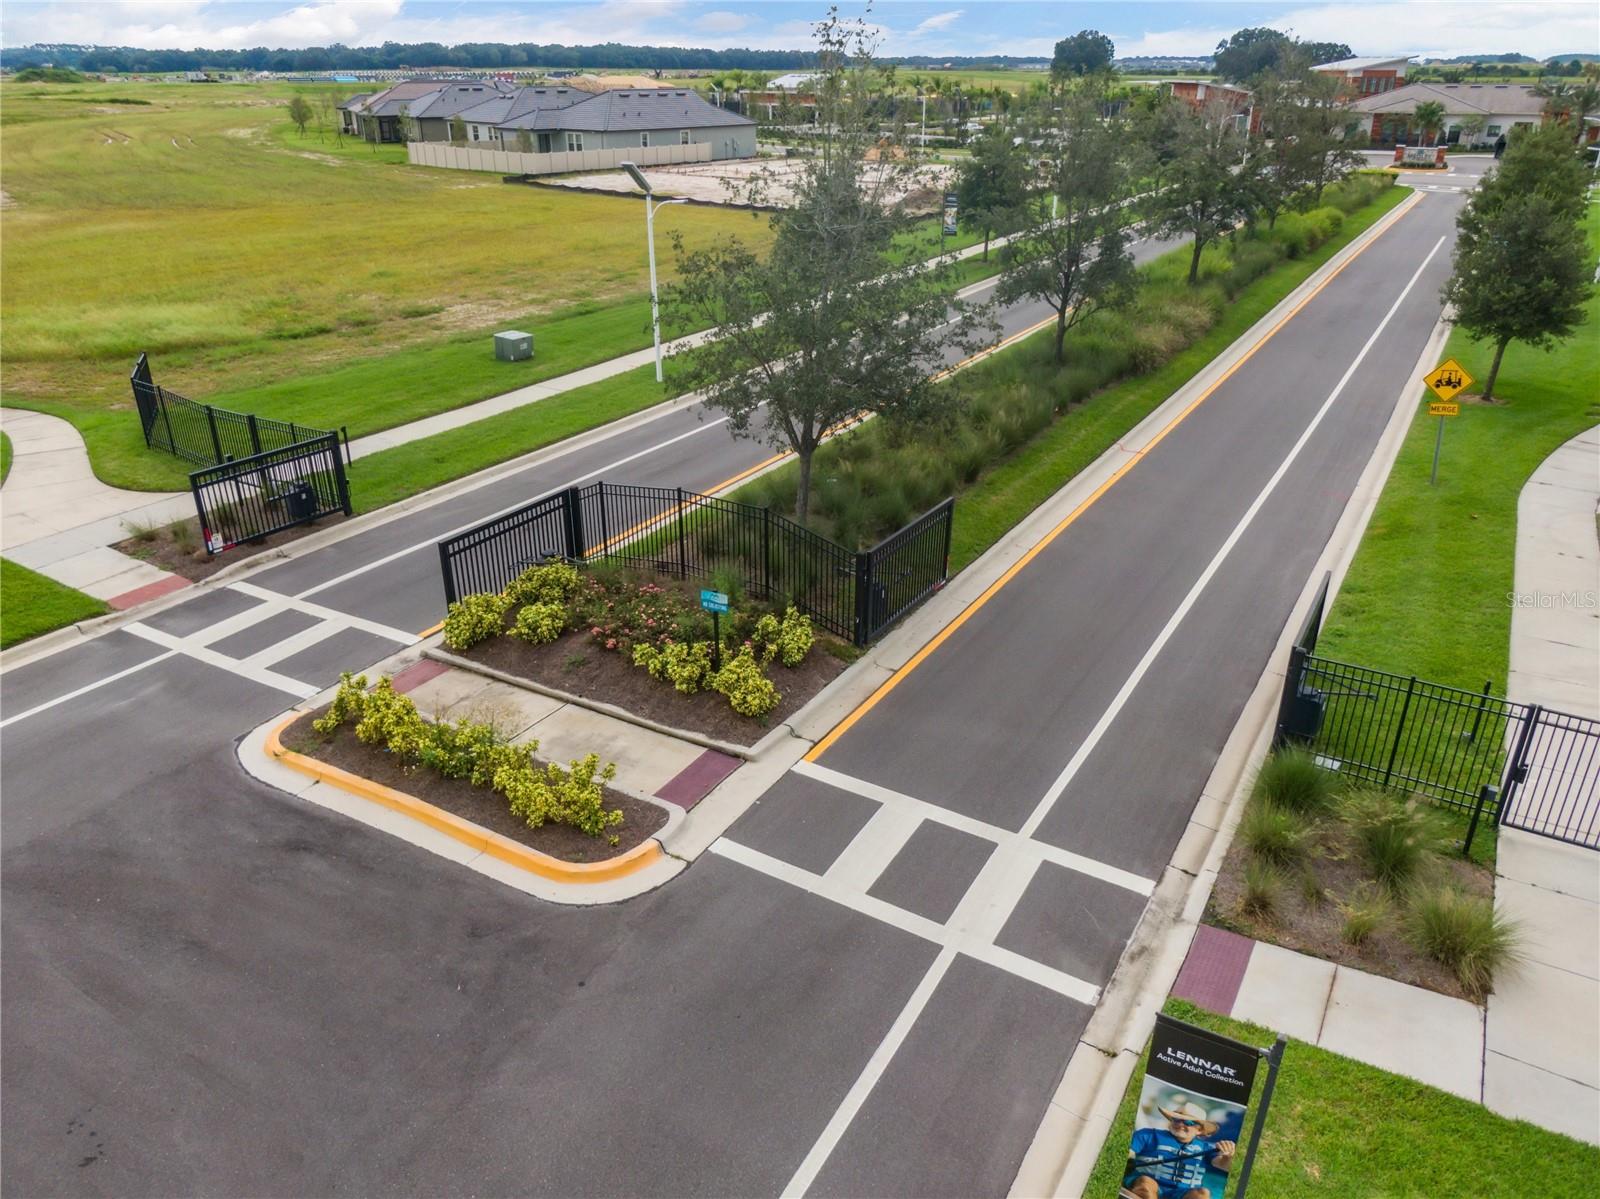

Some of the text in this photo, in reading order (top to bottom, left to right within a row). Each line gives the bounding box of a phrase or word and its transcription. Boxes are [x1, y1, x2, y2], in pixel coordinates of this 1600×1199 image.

[1156, 1052, 1244, 1087] Active Adult Collection
[1166, 1046, 1236, 1077] LENNAR
